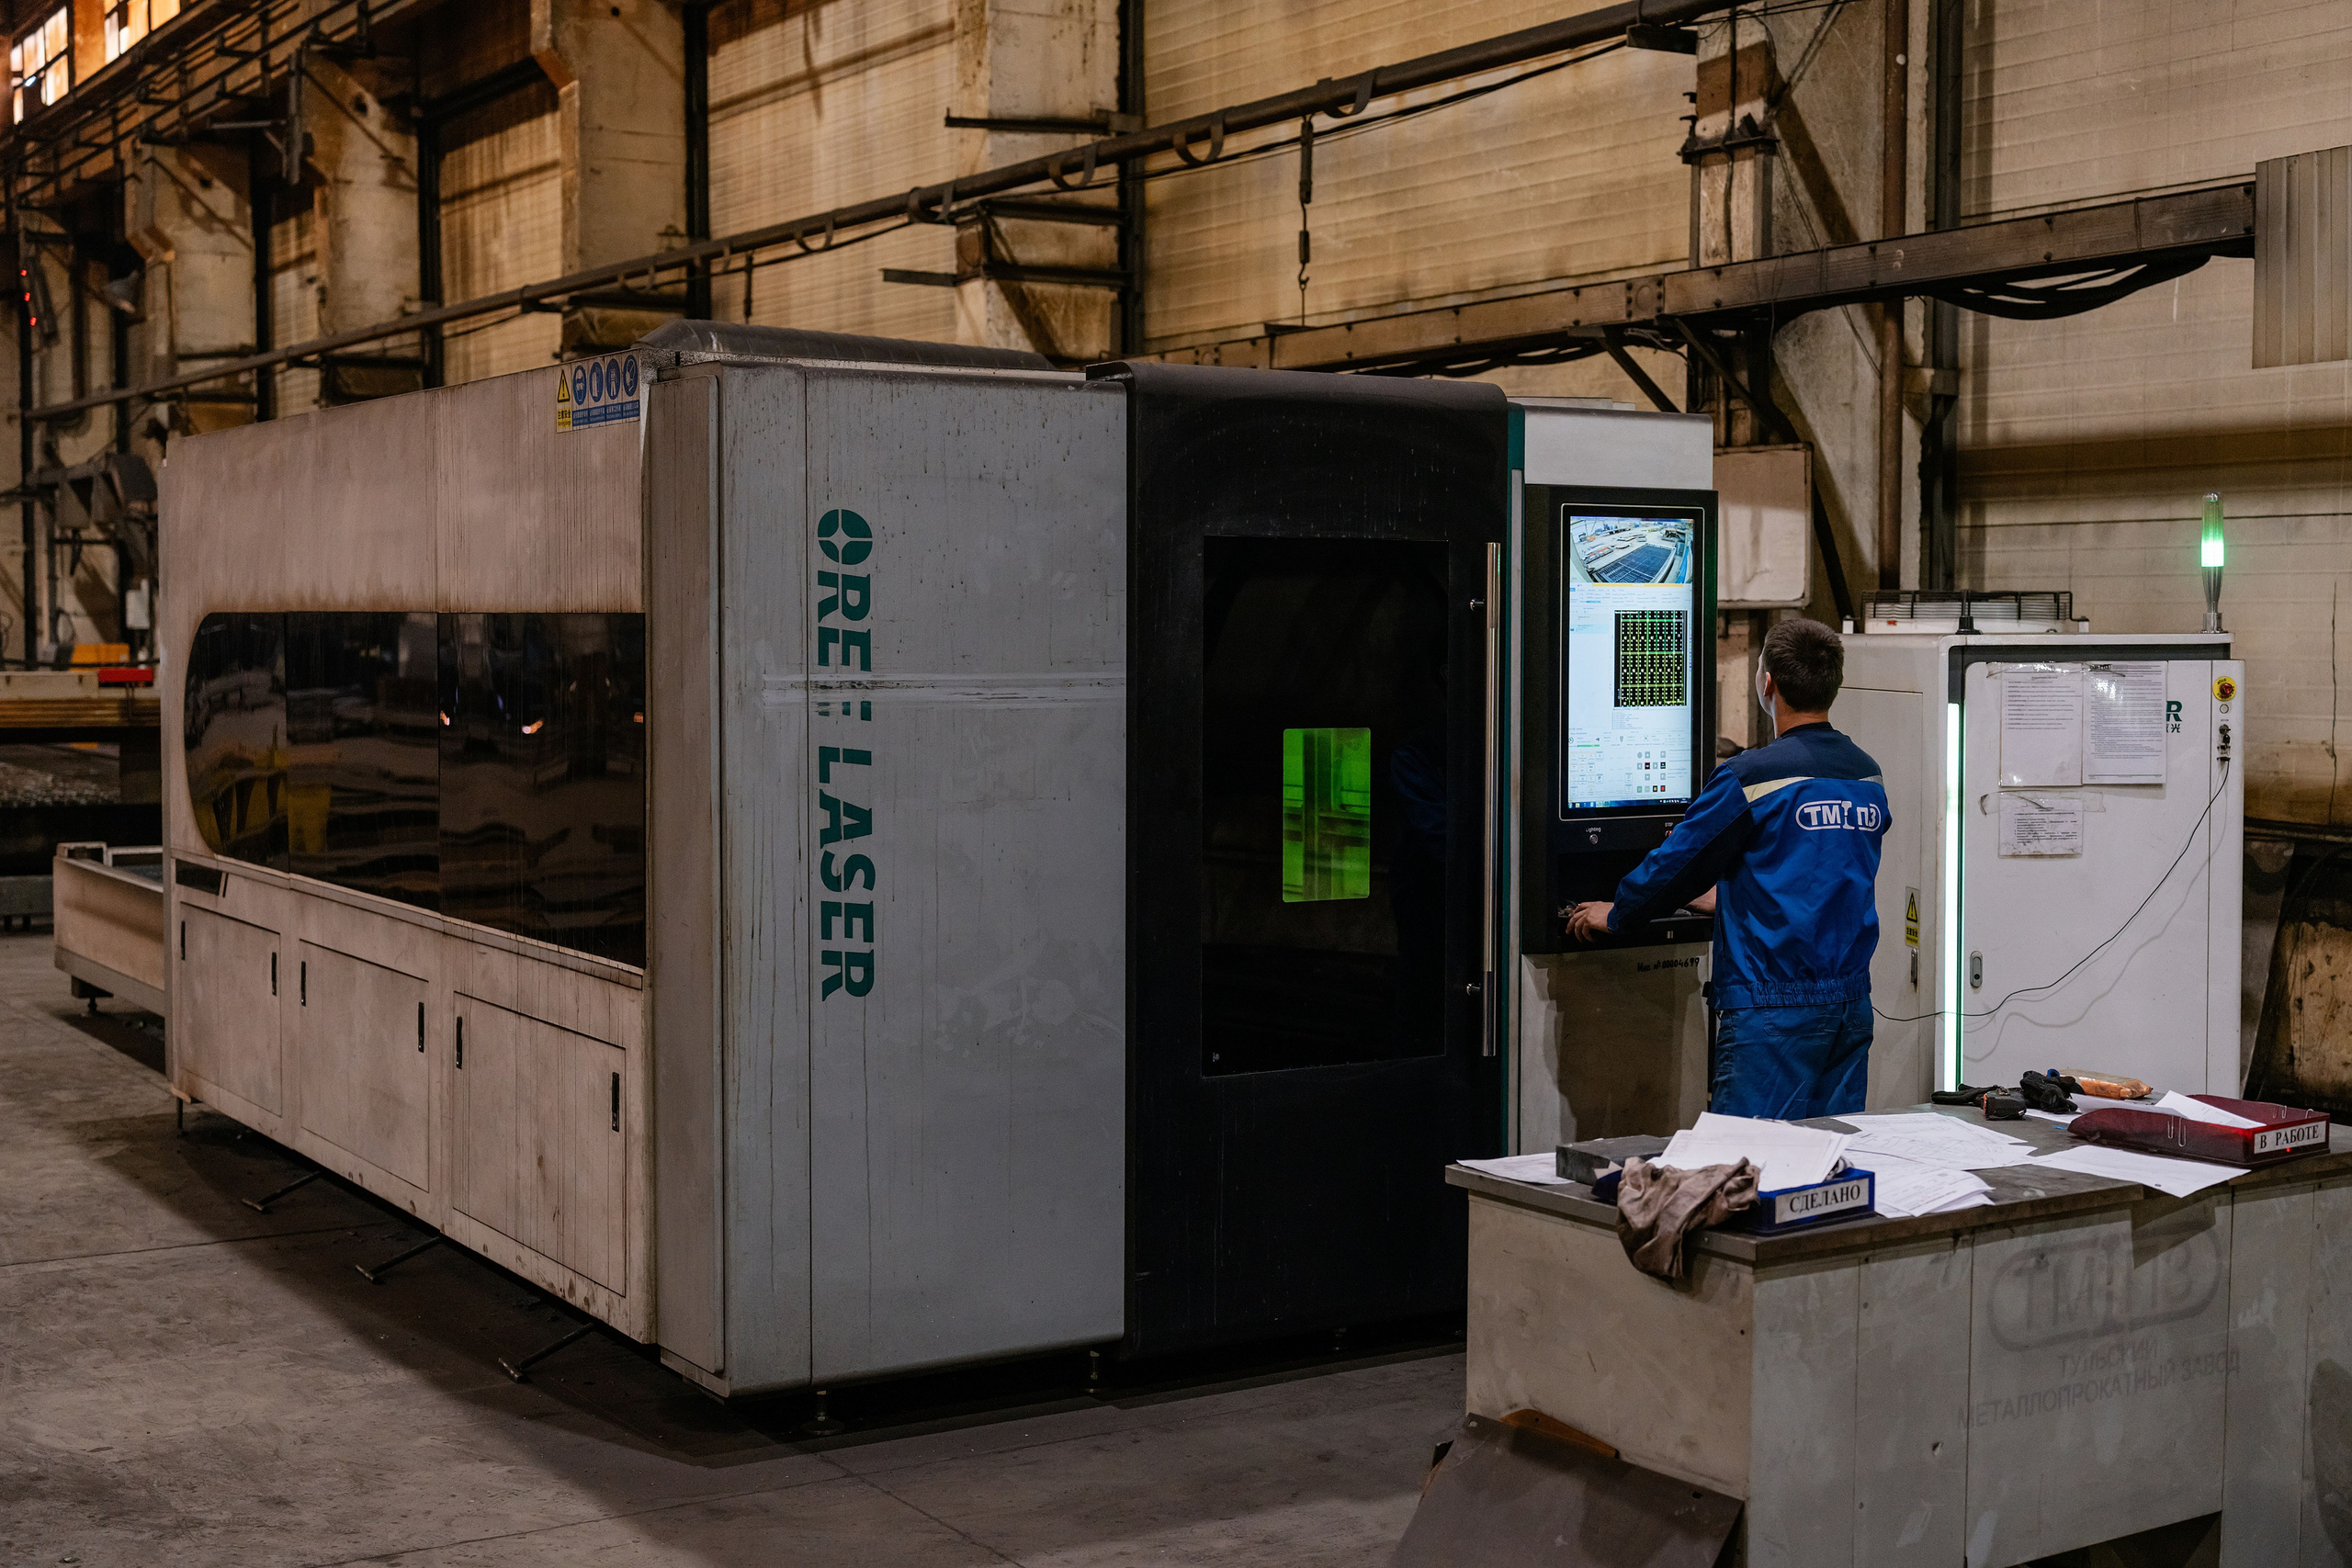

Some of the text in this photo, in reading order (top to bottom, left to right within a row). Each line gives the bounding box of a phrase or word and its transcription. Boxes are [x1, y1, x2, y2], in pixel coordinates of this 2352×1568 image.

[819, 746, 876, 1002] LASER
[2259, 1124, 2319, 1149] В РАБОТЕ
[1789, 1184, 1861, 1213] СДЕЛАНО
